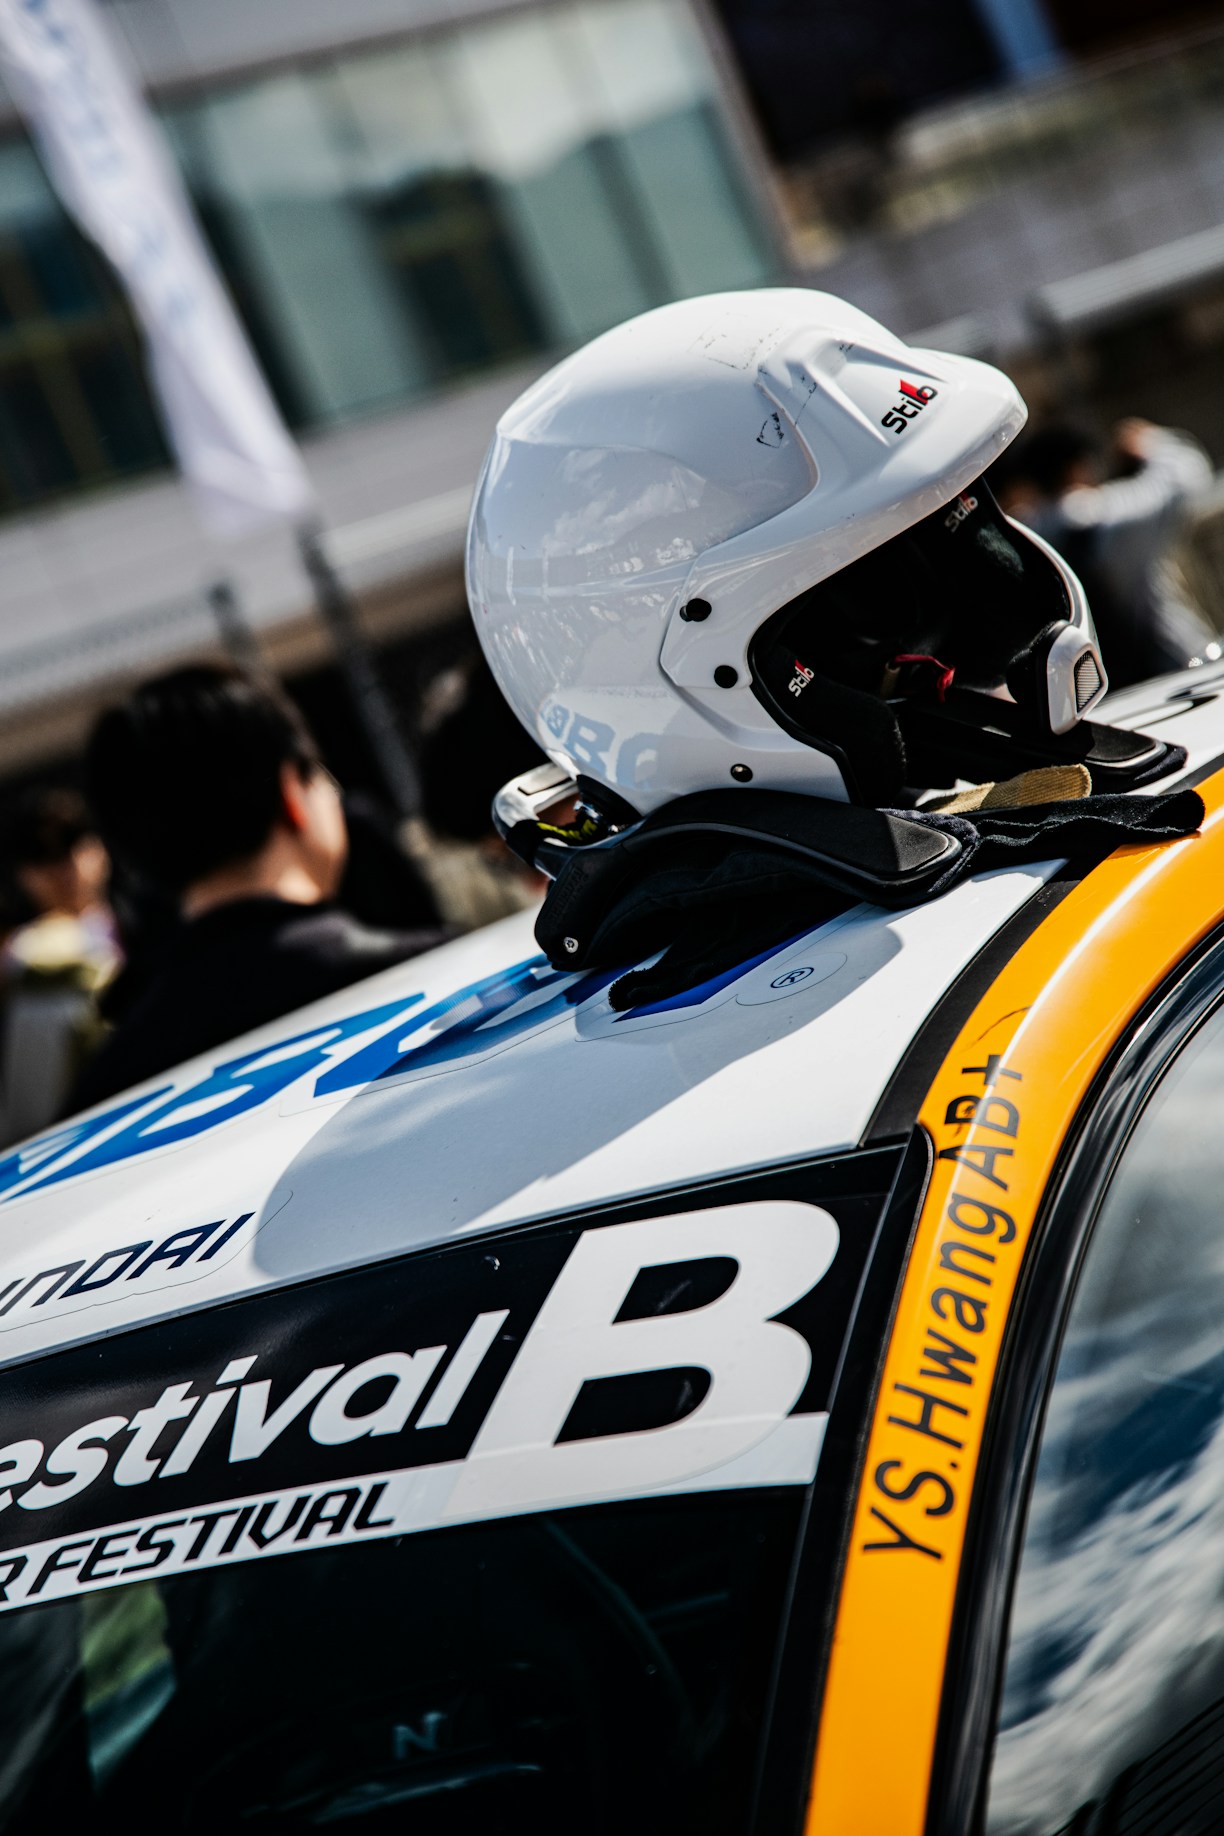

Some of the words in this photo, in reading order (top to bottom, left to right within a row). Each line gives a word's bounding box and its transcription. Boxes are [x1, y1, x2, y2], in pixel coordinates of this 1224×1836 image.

[881, 382, 938, 434] Stilo
[945, 494, 979, 532] Stilo
[788, 664, 815, 697] Stilo
[938, 1054, 1023, 1192] AB+
[0, 1211, 256, 1317] NDAI
[440, 1199, 840, 1523] B
[861, 1193, 1017, 1563] YS.Hwang
[26, 1482, 395, 1598] FESTIVAL
